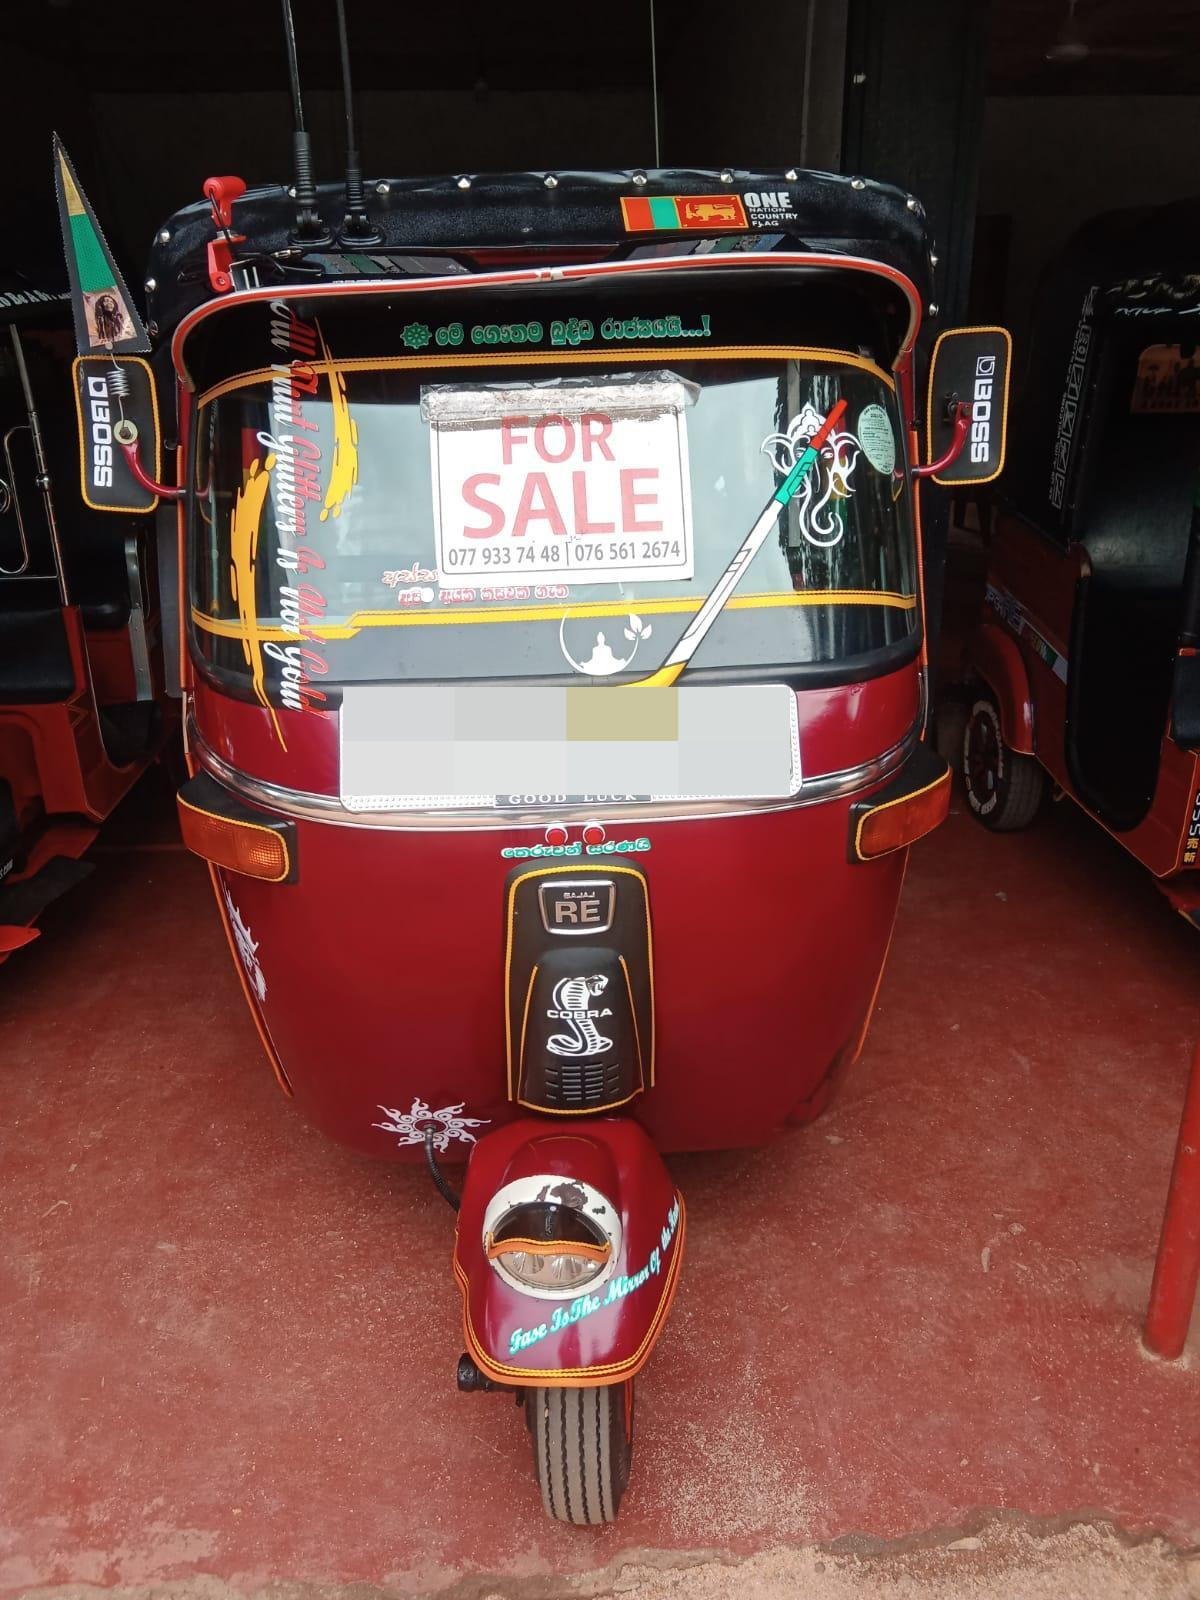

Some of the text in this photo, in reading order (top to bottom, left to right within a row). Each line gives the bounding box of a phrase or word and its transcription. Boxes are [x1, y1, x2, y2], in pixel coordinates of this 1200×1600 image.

[744, 192, 793, 208] ONE
[435, 322, 464, 346] මේ
[970, 378, 993, 463] BOSS
[90, 400, 113, 488] BOSS
[501, 412, 616, 465] FOR
[256, 300, 331, 719] All That Glitters Is Not Gold
[461, 468, 664, 539] SALE
[448, 540, 680, 566] 077 933 74 48 076 561 2674
[508, 795, 567, 804] GOOD
[555, 900, 601, 923] RE
[546, 1008, 613, 1019] COBRA
